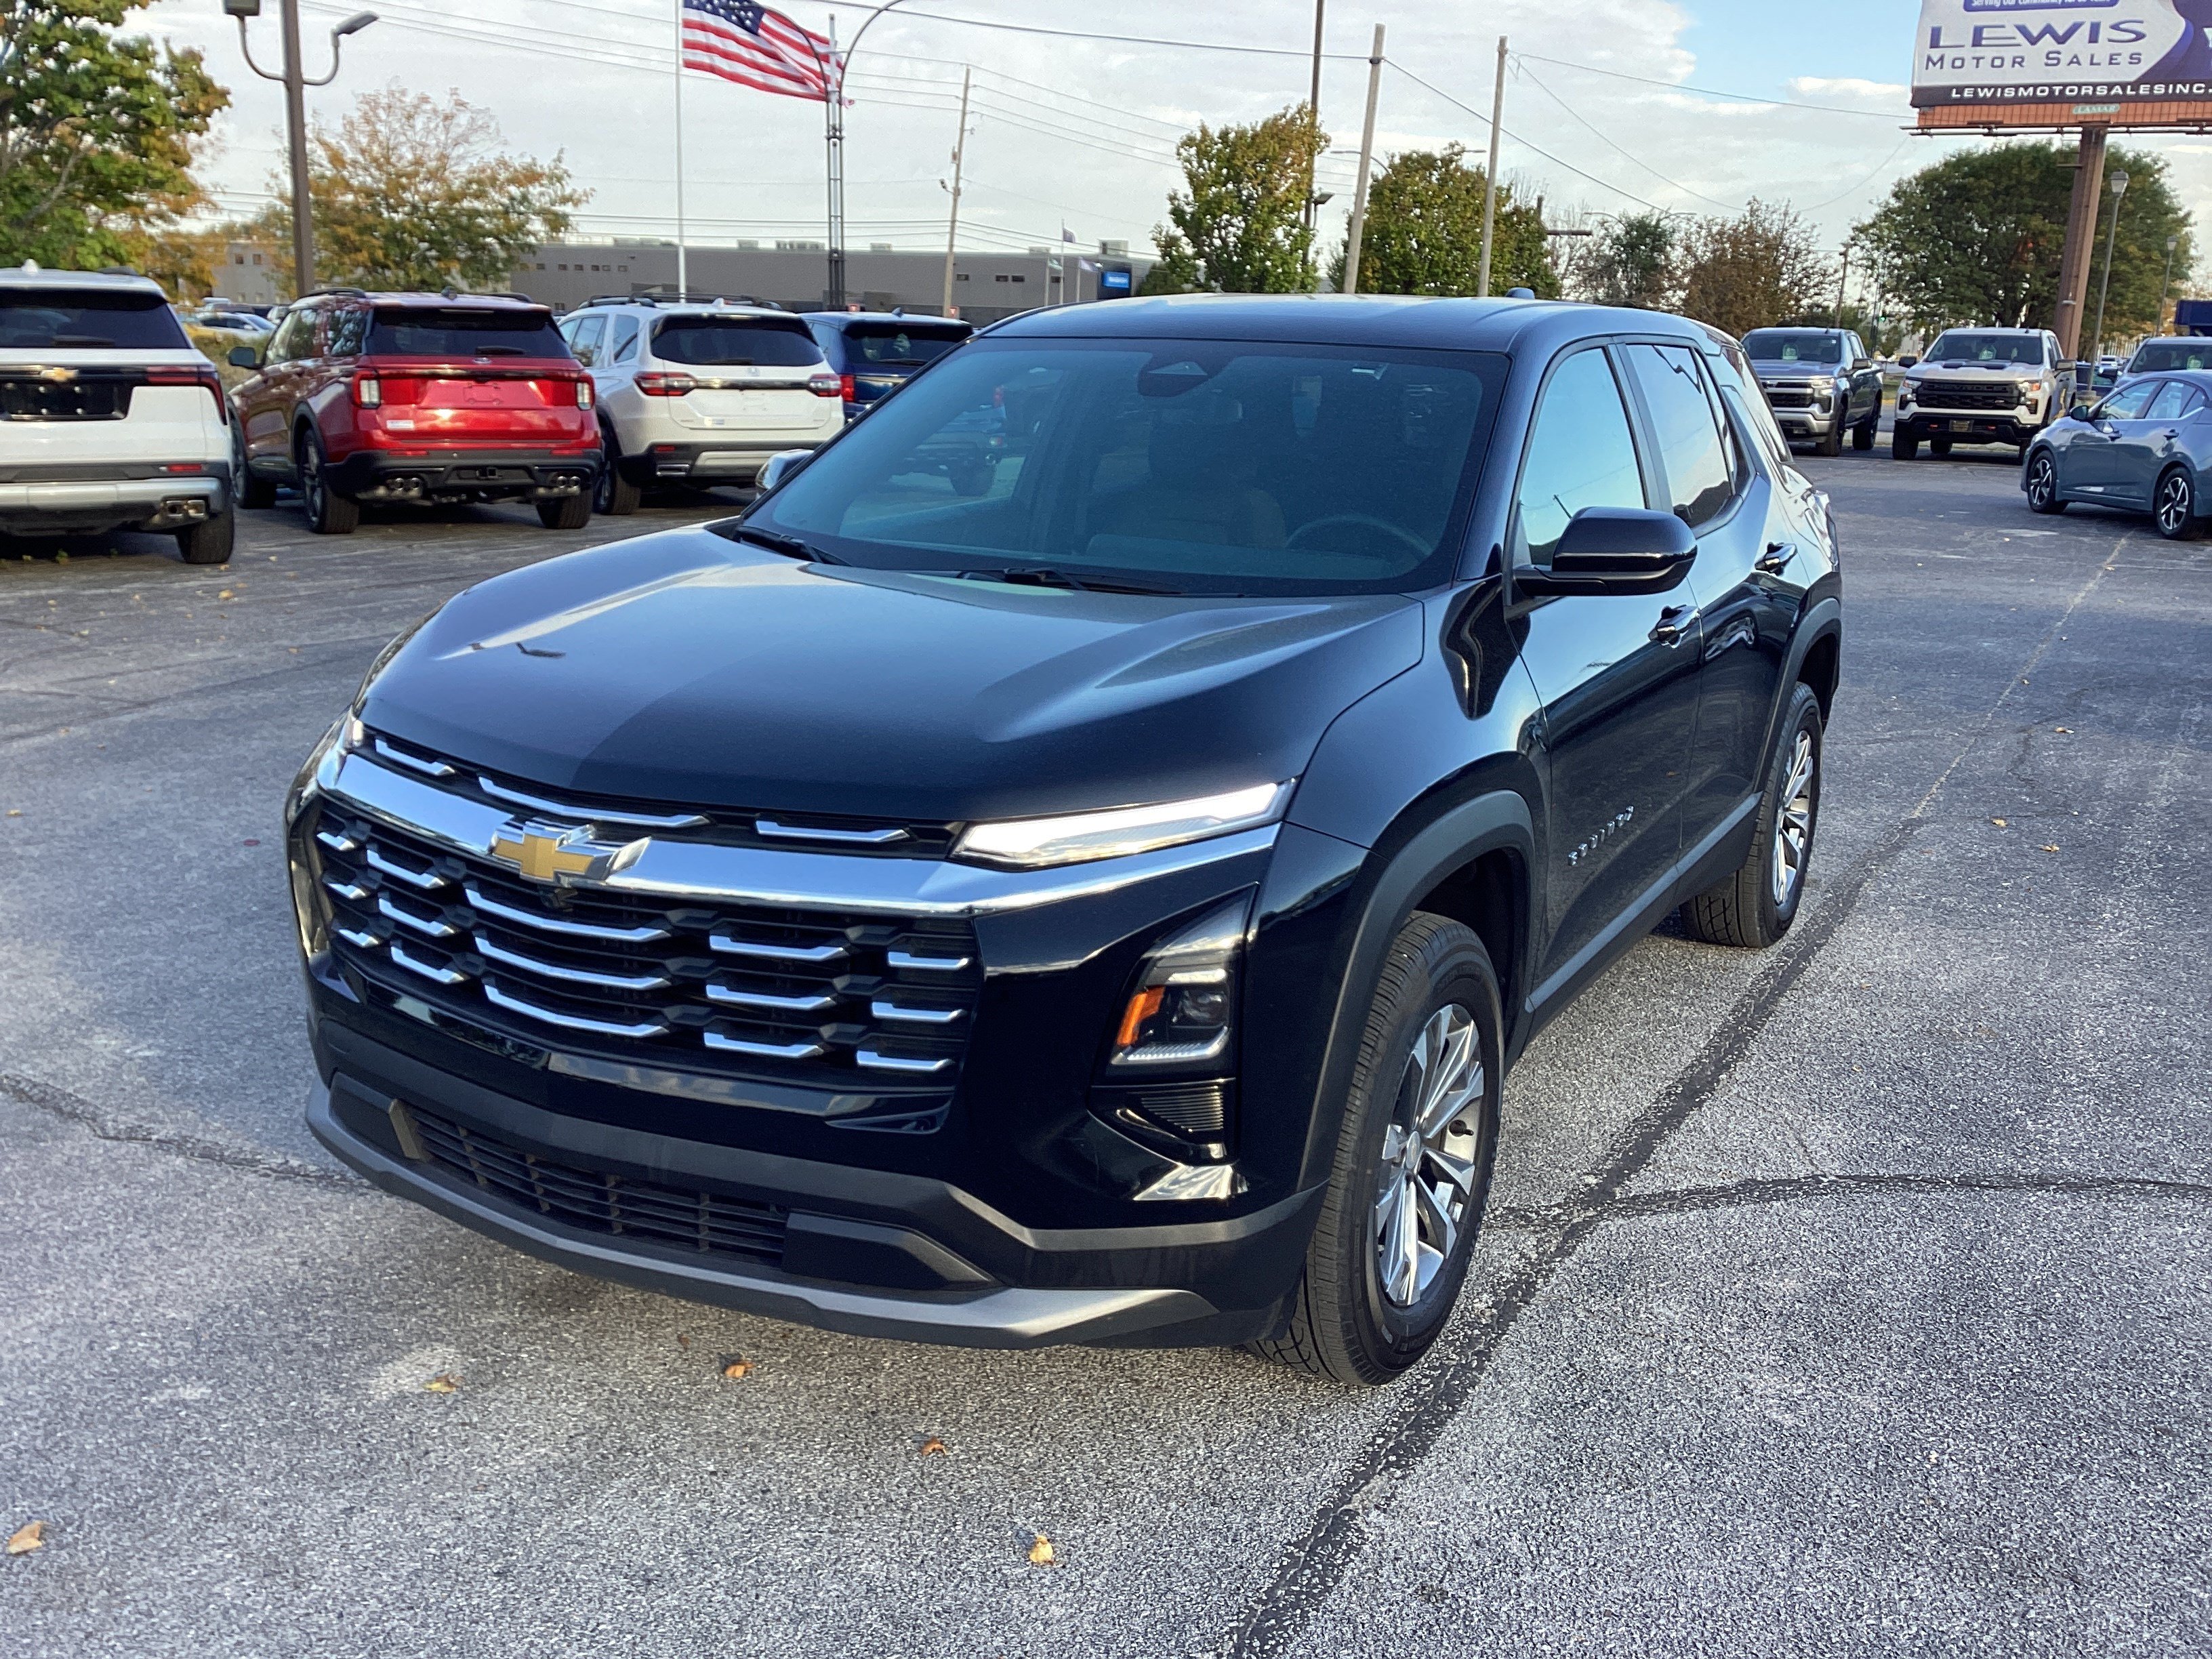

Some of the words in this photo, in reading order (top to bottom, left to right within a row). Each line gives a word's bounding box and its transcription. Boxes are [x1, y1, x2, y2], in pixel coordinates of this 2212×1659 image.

[1929, 20, 2147, 49] LEWIS
[1925, 53, 2024, 70] MOTOR
[2045, 50, 2142, 67] SALES
[1568, 805, 1634, 867] EQUINOX
